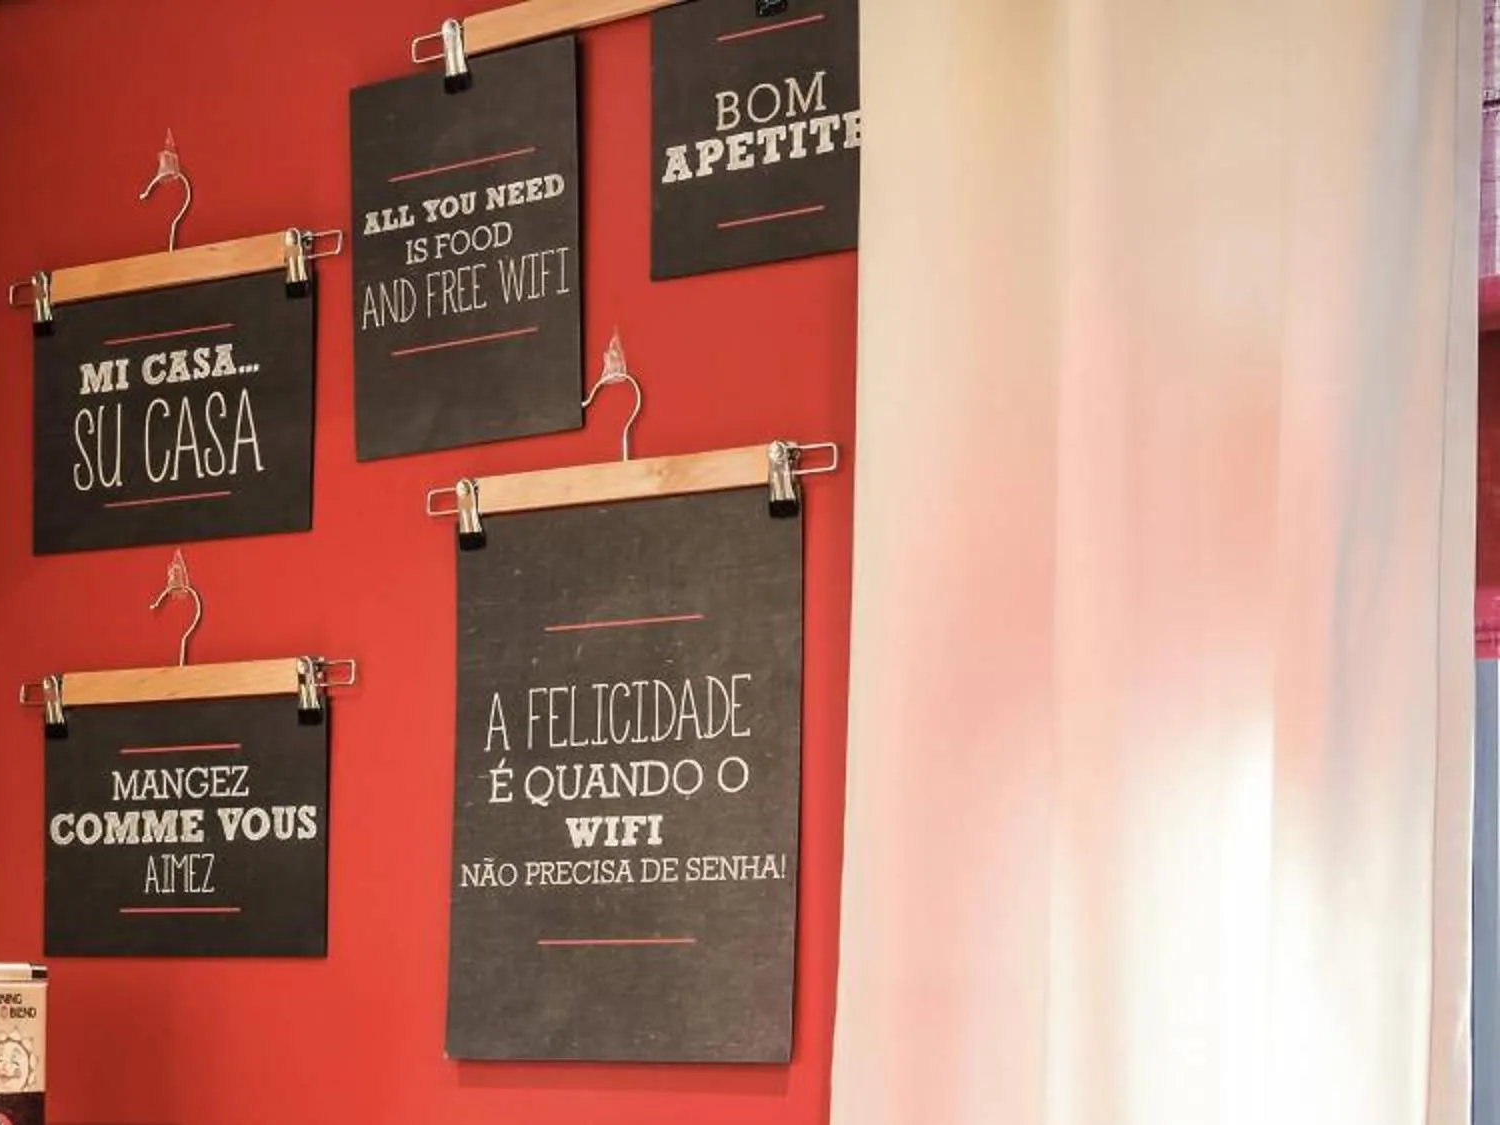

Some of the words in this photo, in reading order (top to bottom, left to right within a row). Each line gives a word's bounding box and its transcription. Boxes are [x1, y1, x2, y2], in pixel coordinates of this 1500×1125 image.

[714, 71, 827, 132] BOM
[363, 205, 416, 235] ALL
[422, 192, 477, 223] YOU
[485, 173, 566, 211] NEED
[405, 237, 429, 265] IS
[434, 221, 513, 259] FOOD
[361, 278, 418, 331] AND
[426, 263, 488, 319] FREE
[497, 247, 571, 305] WIFI
[78, 358, 130, 395] MI
[141, 343, 260, 386] CASA...
[73, 403, 123, 491] SU
[144, 388, 265, 483] CASA
[483, 692, 511, 752] A
[527, 673, 752, 750] FELICIDADE
[111, 765, 250, 801] MANGEZ
[488, 757, 514, 803] É
[524, 758, 704, 807] QUANDO
[716, 756, 750, 793] O
[50, 809, 205, 846] COMME
[217, 805, 318, 842] VOUS
[565, 814, 664, 849] WIFI
[143, 853, 216, 894] AIMEZ
[460, 857, 518, 888] NÃO
[524, 859, 635, 887] PRECISA
[640, 857, 679, 884] DE
[685, 853, 787, 883] SENHA!
